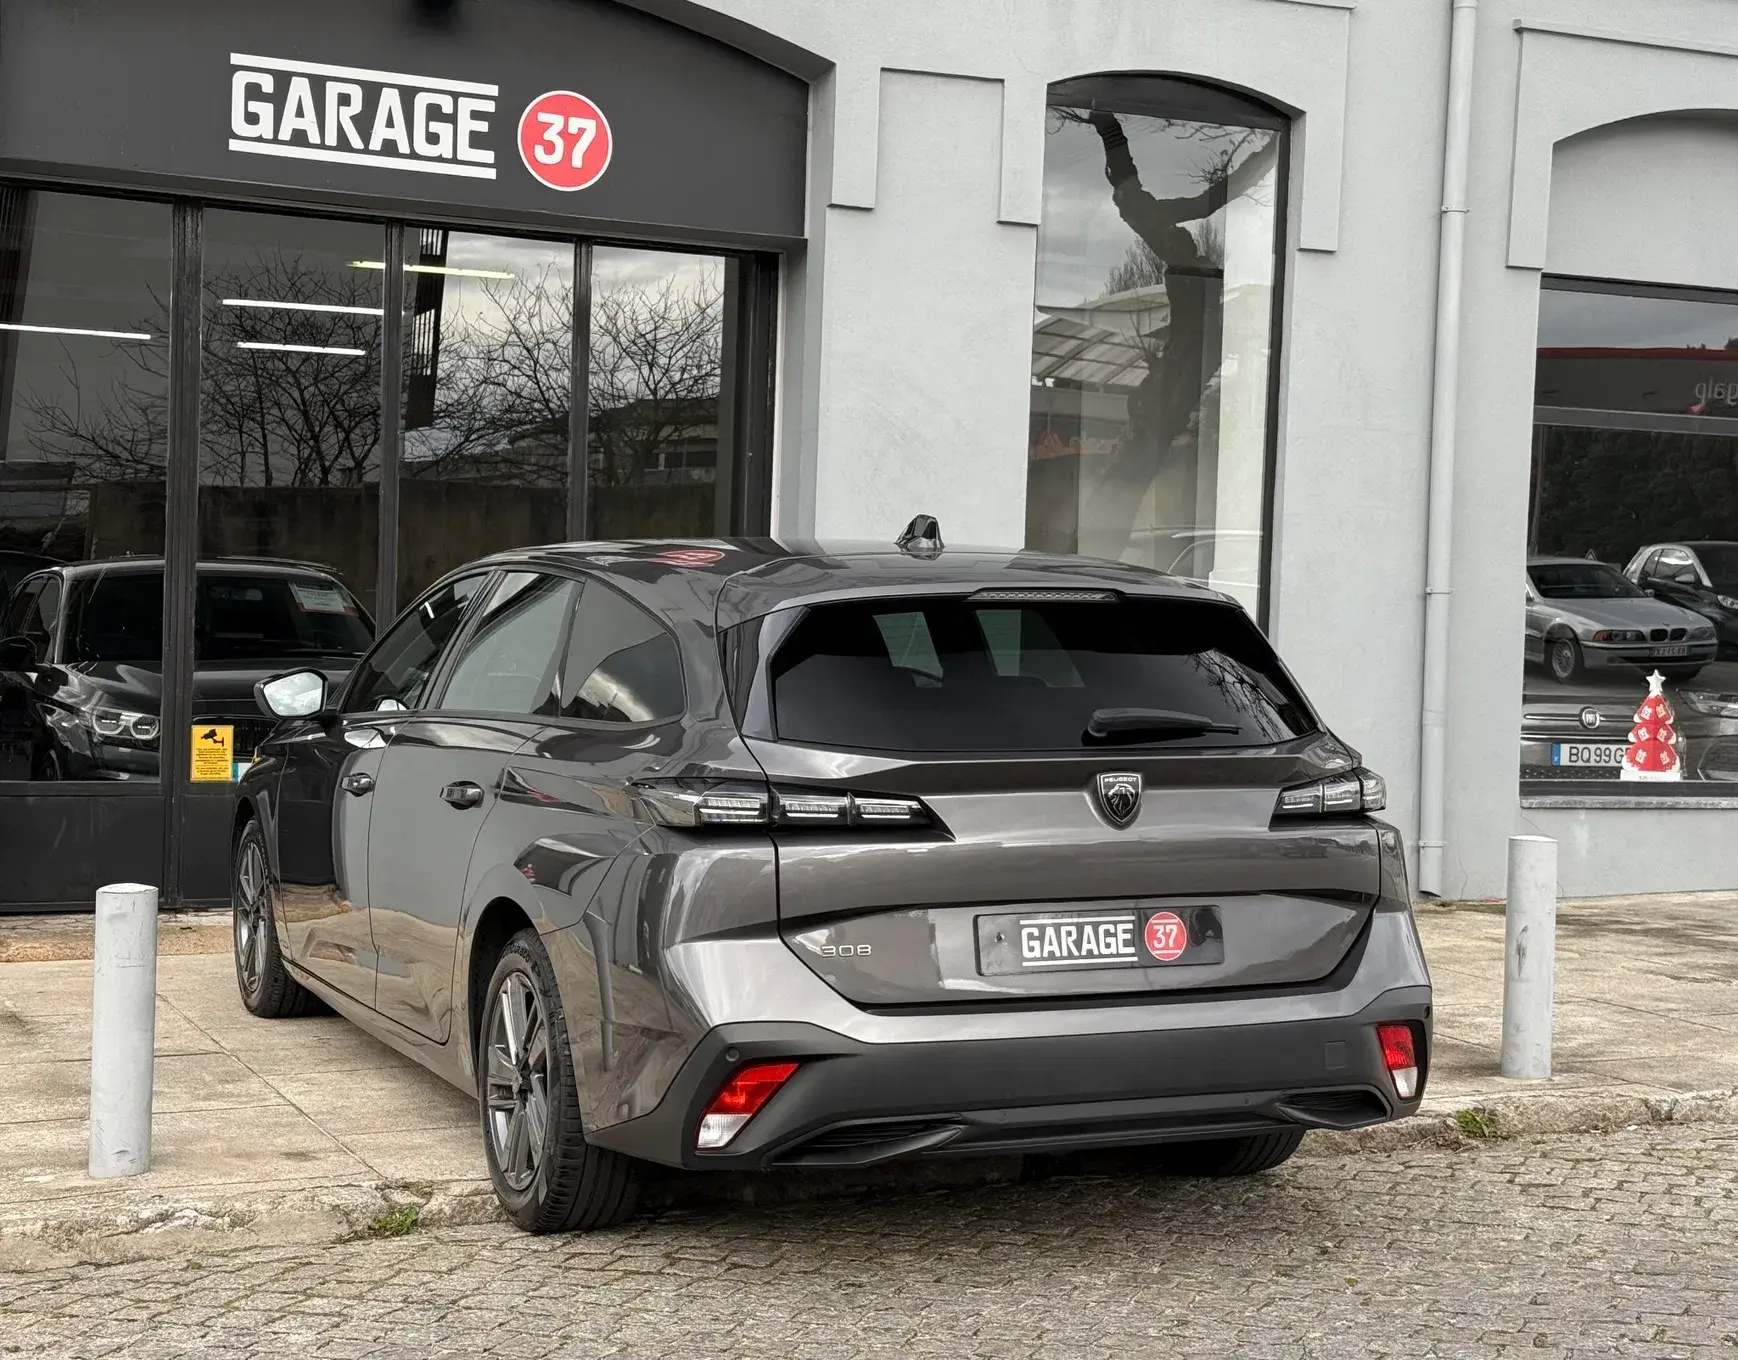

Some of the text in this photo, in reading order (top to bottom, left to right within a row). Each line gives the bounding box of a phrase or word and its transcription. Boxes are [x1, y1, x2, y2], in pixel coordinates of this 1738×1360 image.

[231, 70, 597, 169] GARAGE 37
[821, 944, 872, 958] 308
[1021, 922, 1179, 959] GARAGE 37
